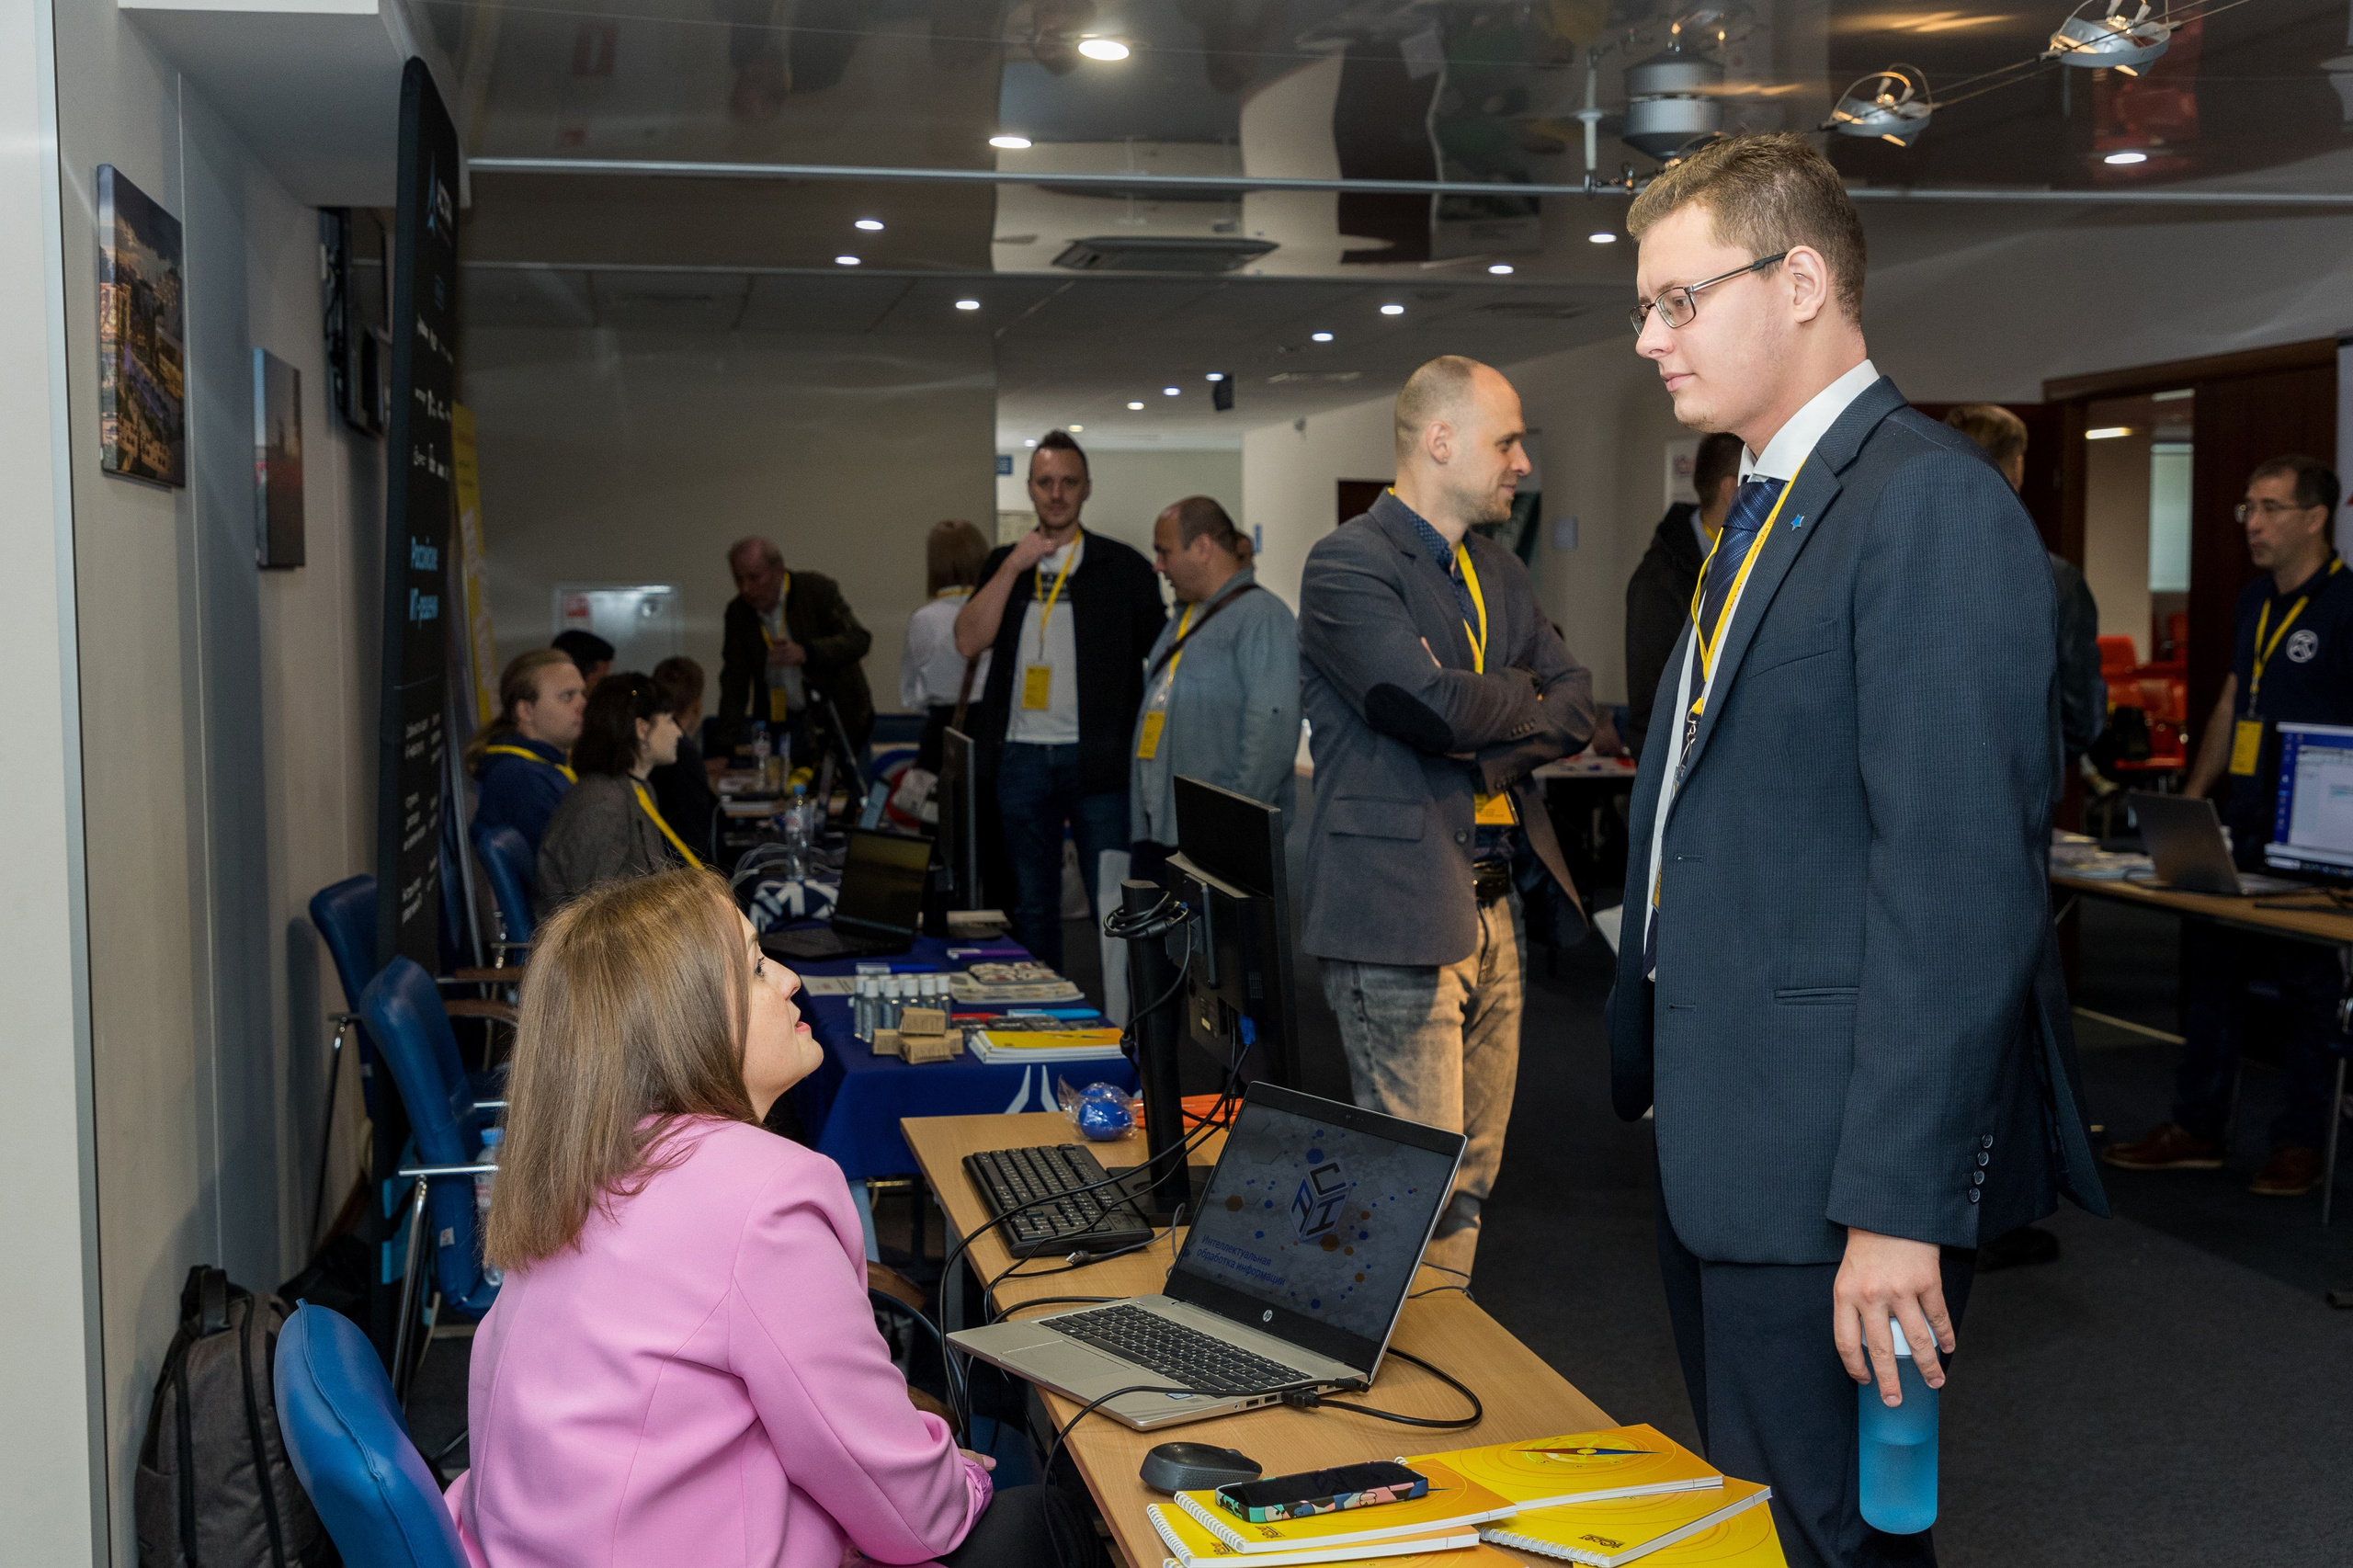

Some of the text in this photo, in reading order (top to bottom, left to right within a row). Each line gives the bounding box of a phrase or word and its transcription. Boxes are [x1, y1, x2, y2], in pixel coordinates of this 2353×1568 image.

[1197, 1247, 1287, 1286] обработка информации
[1201, 1233, 1272, 1267] Интеллектуальная
